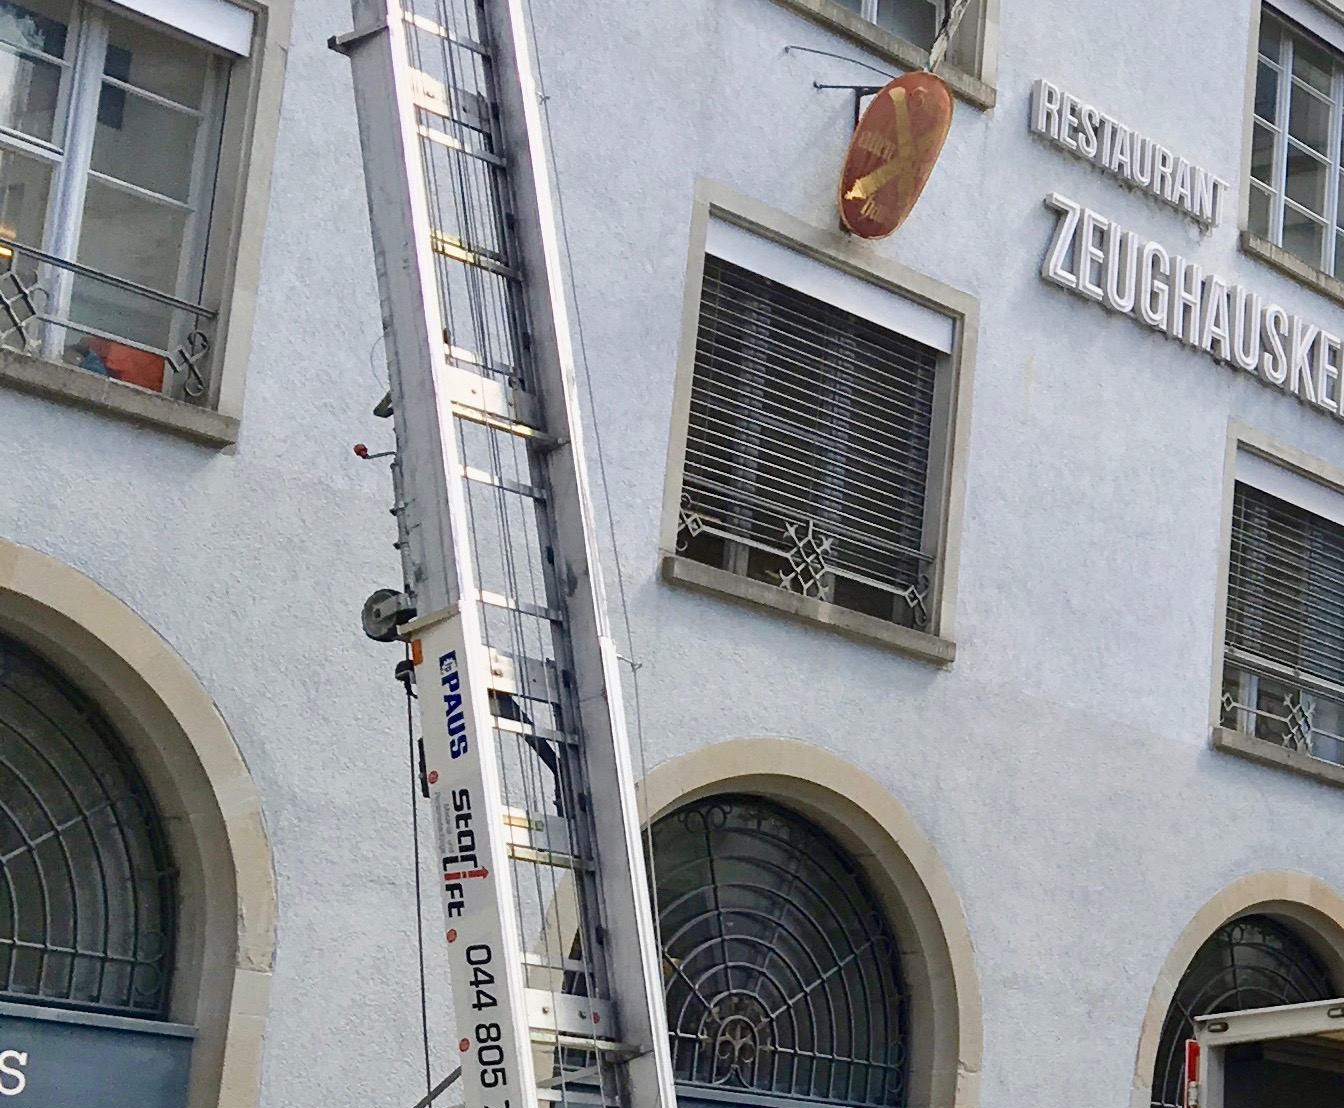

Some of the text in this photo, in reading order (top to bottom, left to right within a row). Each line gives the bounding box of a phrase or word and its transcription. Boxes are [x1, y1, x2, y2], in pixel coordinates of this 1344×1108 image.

[1030, 77, 1231, 228] RESTAURANT
[441, 670, 468, 760] PAUS
[466, 944, 498, 1011] 044
[475, 1022, 507, 1088] 805
